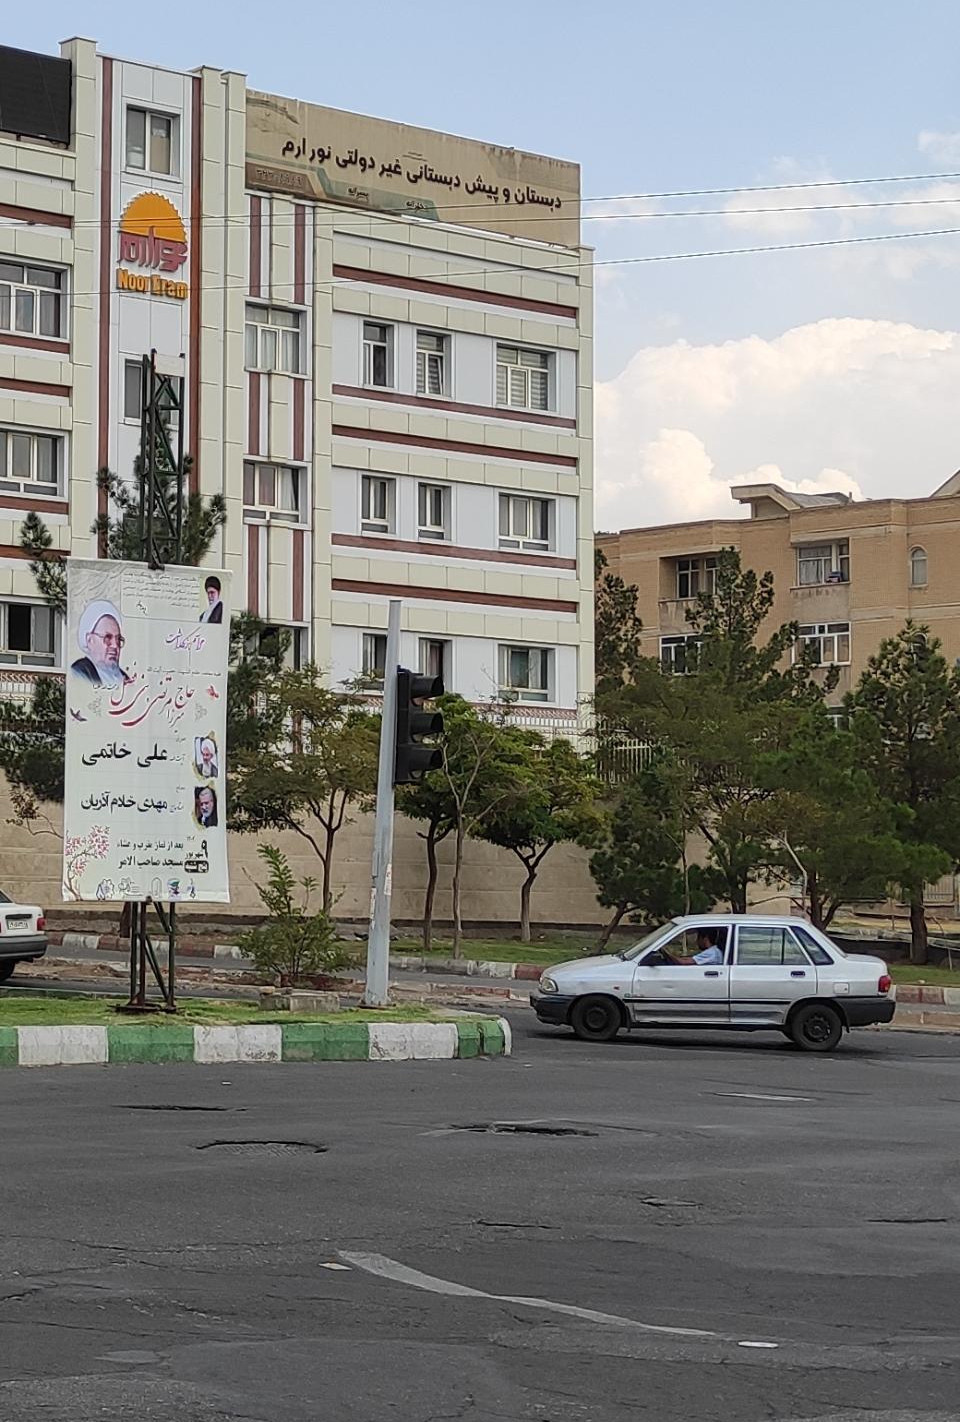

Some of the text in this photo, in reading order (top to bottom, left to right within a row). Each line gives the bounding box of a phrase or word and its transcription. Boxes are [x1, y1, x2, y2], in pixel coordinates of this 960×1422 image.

[281, 137, 306, 159] ارم
[308, 145, 331, 164] نور
[335, 148, 376, 173] دولتی
[379, 158, 402, 178] غیر
[406, 164, 461, 191] دبستانی
[464, 175, 499, 203] پیش
[502, 187, 511, 203] و
[514, 186, 562, 212] دبستان
[116, 268, 188, 300] Noor Eram
[81, 741, 132, 766] خاتمی
[137, 743, 168, 767] علی
[137, 797, 168, 813] مهدی
[161, 859, 184, 869] مسجد
